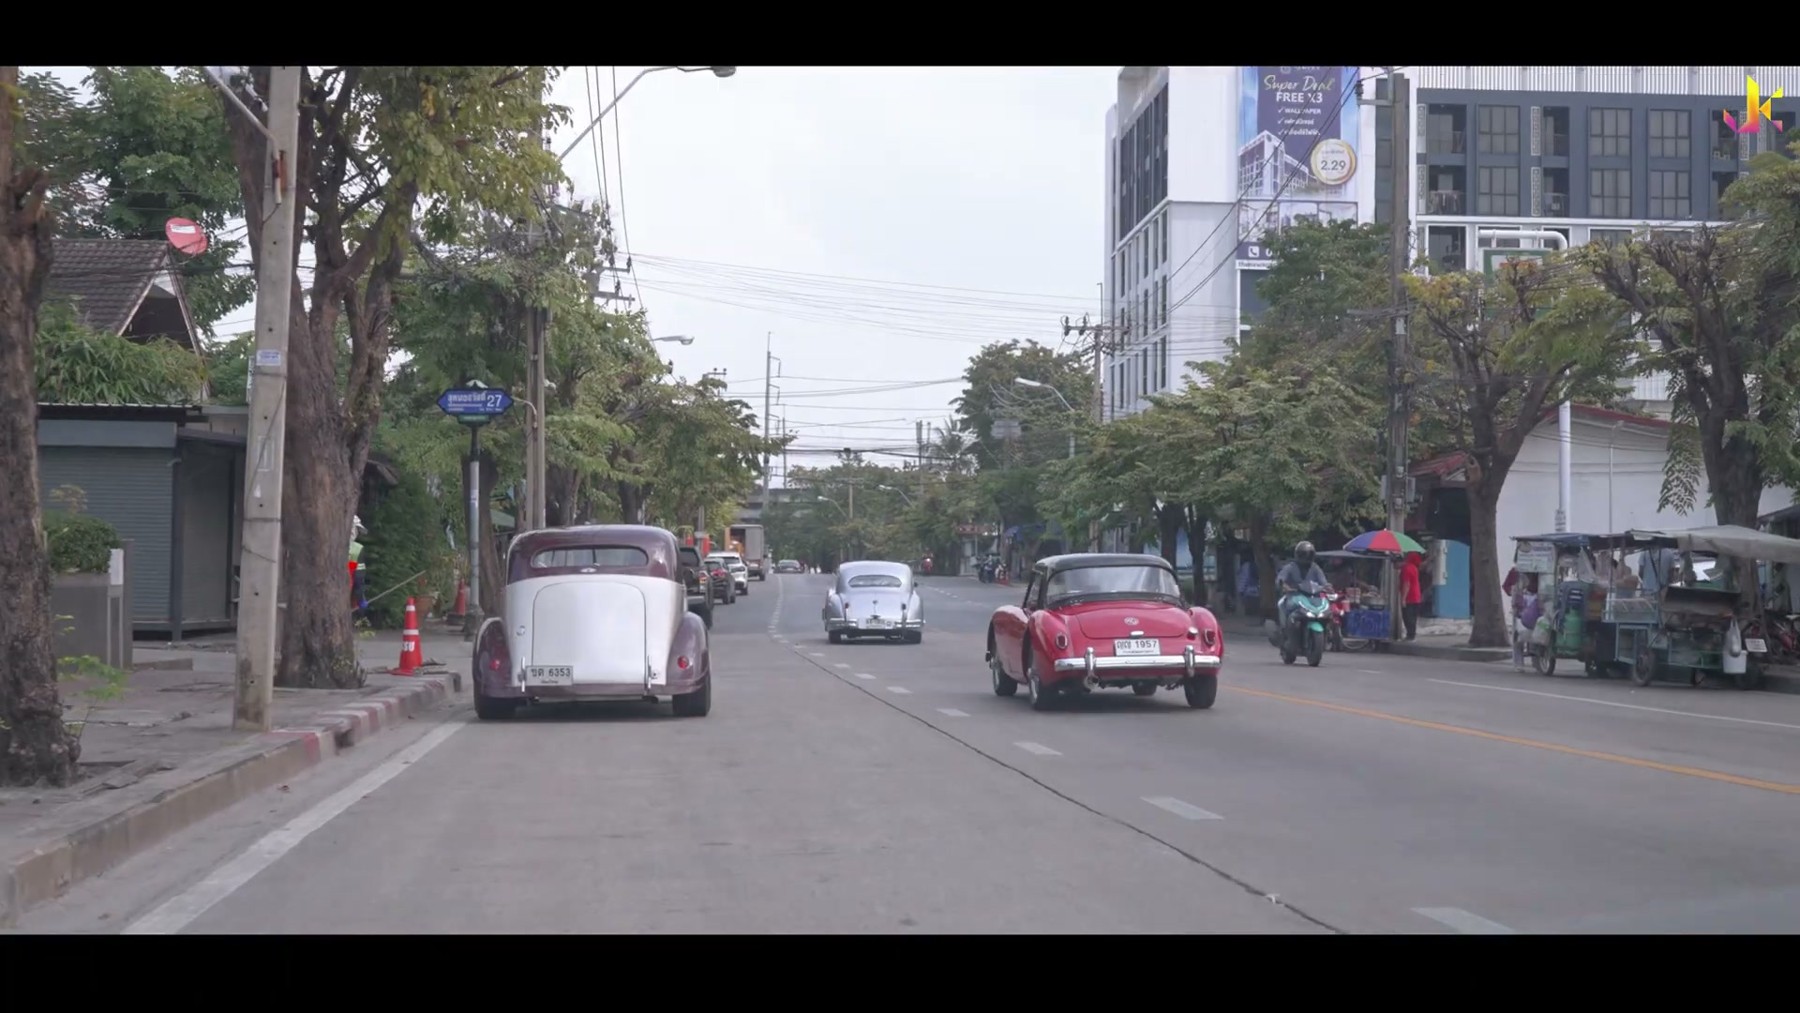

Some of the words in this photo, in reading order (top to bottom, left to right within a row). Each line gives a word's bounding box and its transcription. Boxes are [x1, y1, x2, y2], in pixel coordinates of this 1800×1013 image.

[1264, 75, 1299, 91] Super
[1302, 75, 1335, 91] Deal
[1276, 92, 1304, 103] FREE
[1308, 93, 1323, 103] X3
[1320, 159, 1347, 171] 2.29
[487, 394, 502, 407] 27
[1135, 640, 1157, 649] 1957
[548, 667, 571, 677] 6353
